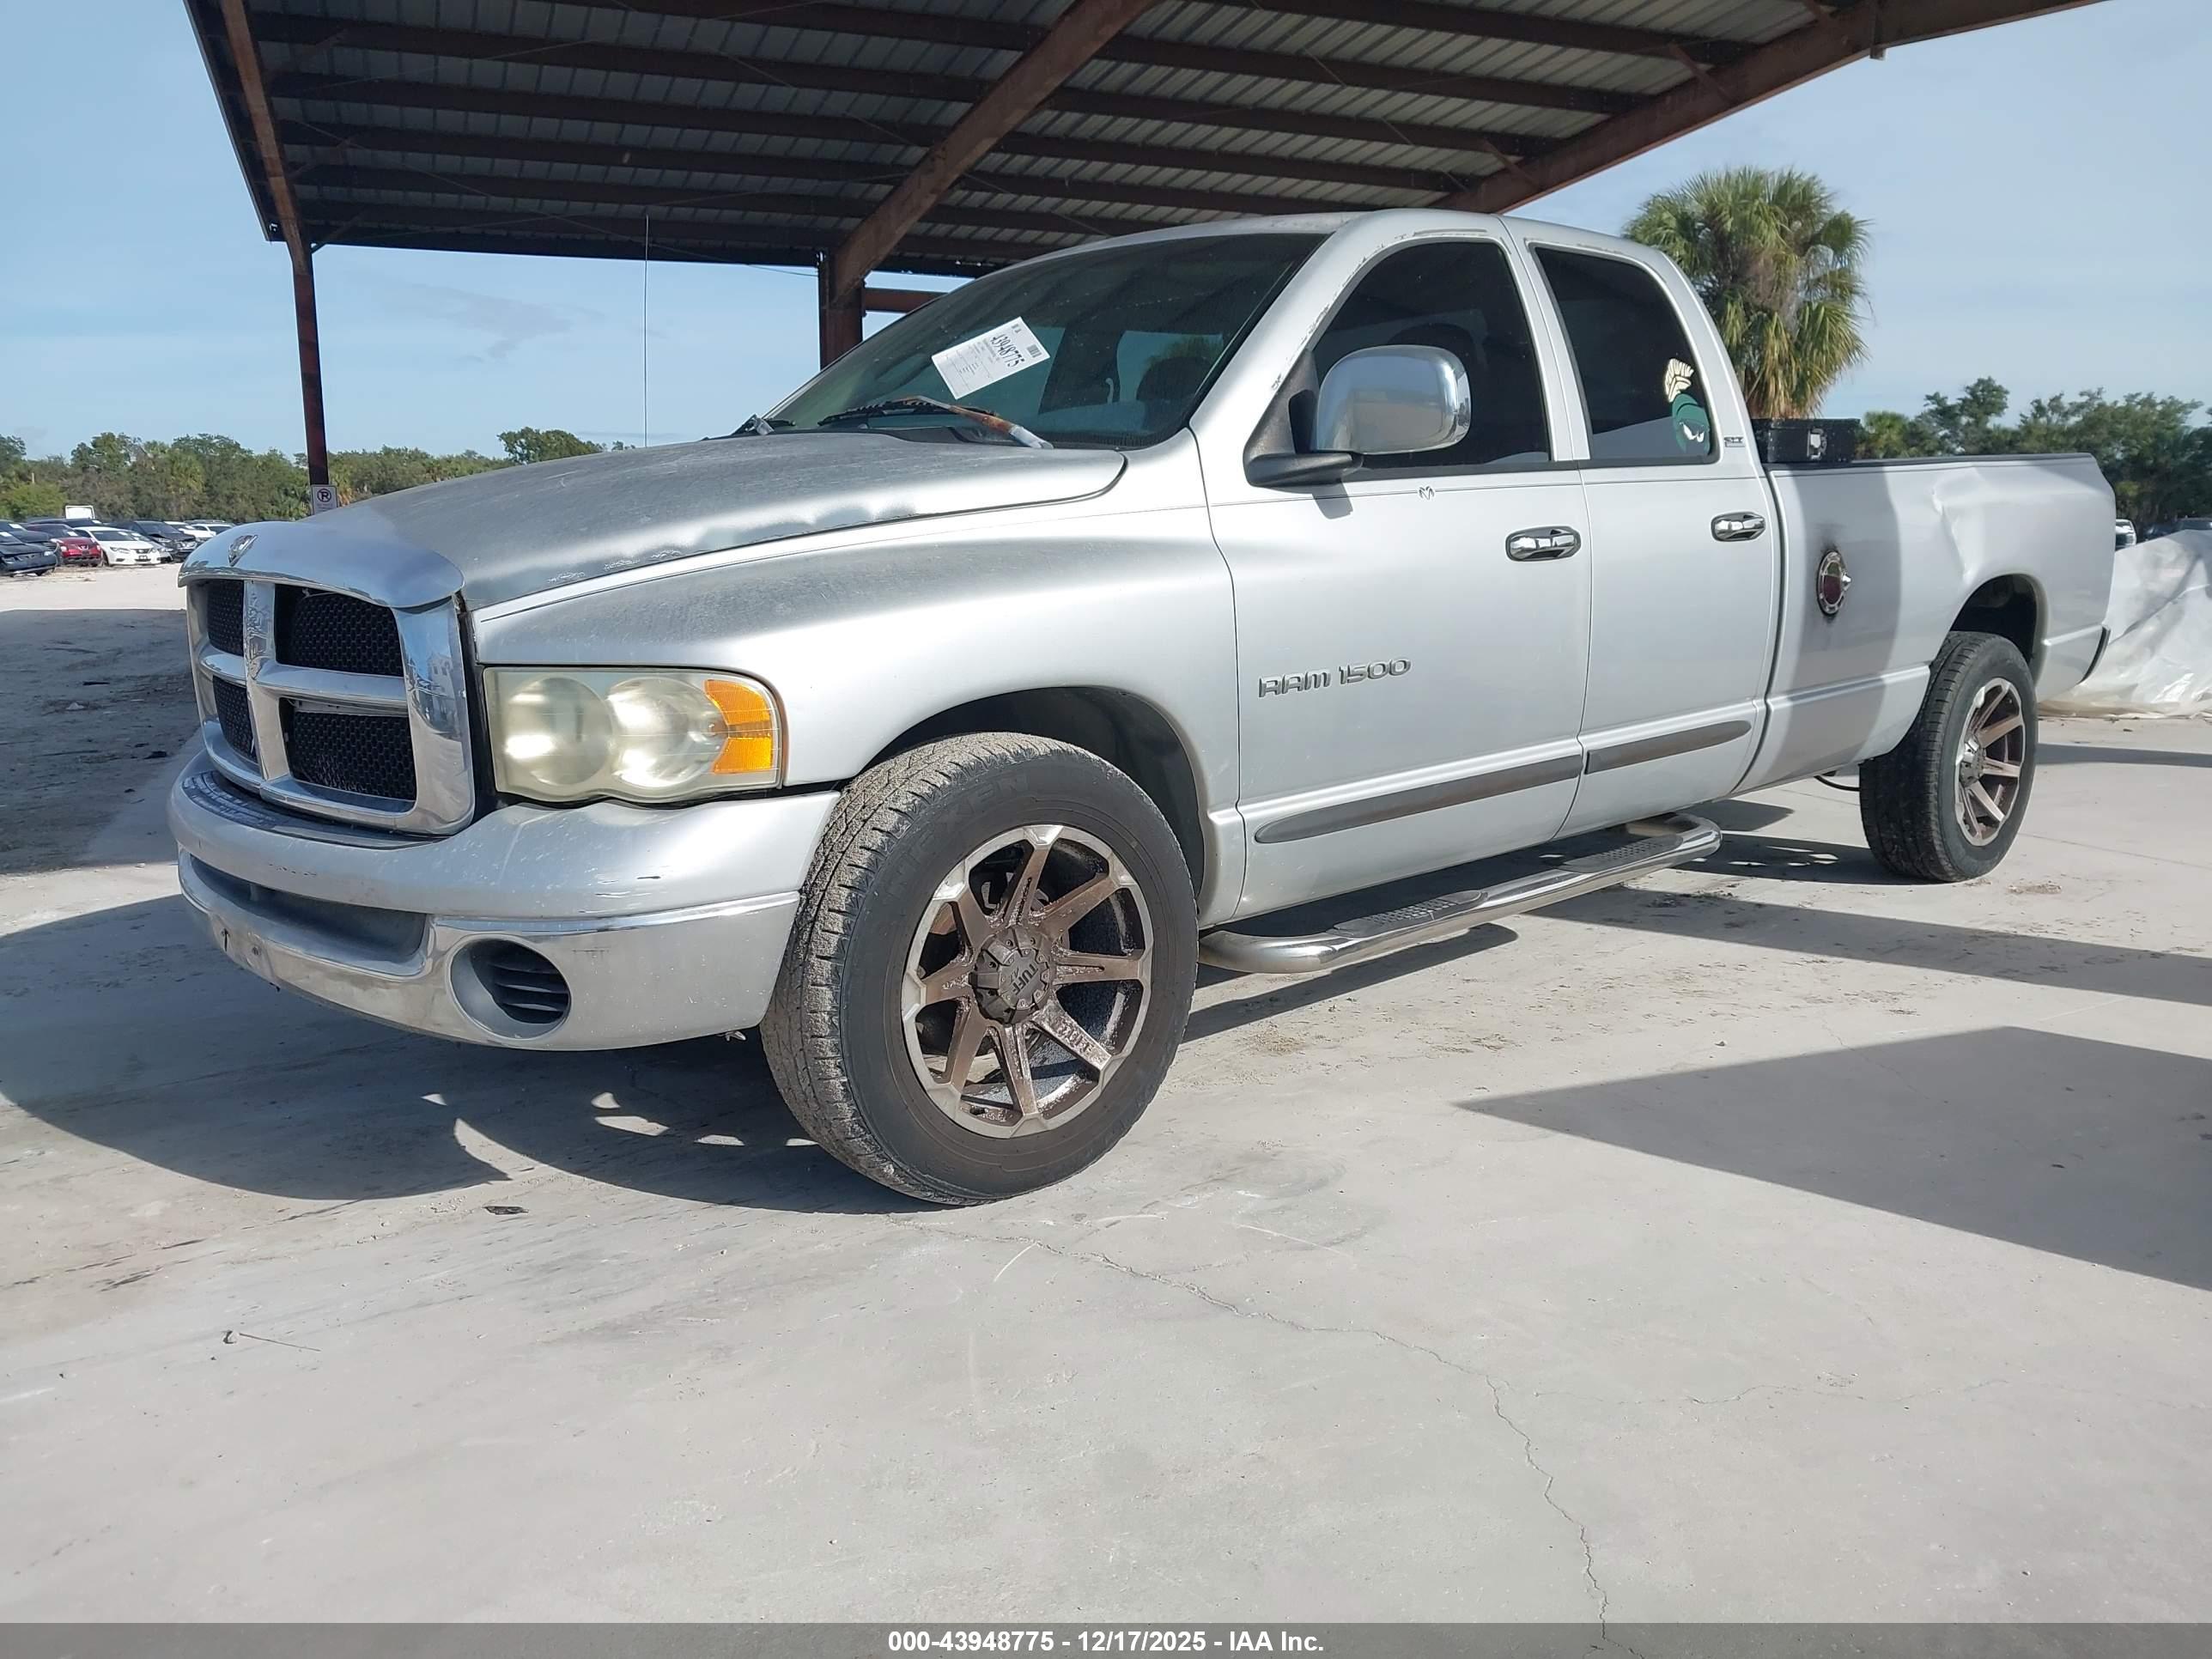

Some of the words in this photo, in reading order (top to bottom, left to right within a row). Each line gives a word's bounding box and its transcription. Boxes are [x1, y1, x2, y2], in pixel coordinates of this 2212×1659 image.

[990, 334, 1025, 368] 43948775
[1258, 668, 1331, 698] RAM
[1338, 657, 1411, 685] 1500
[1012, 963, 1039, 996] TUFF
